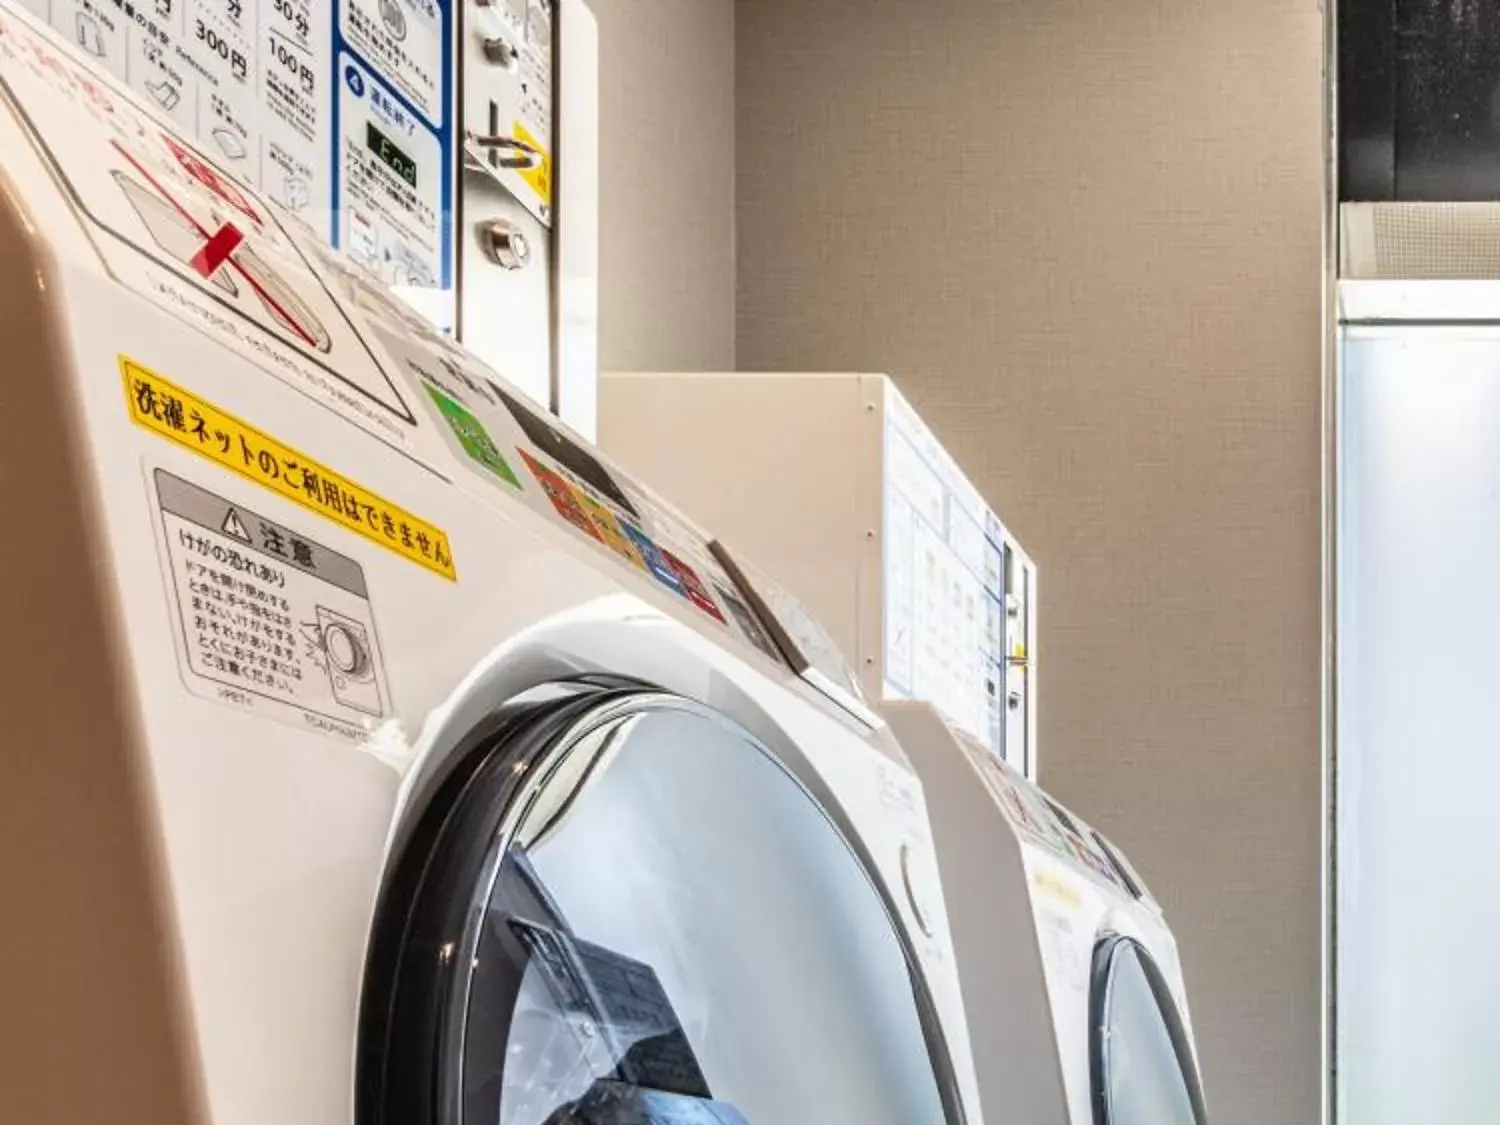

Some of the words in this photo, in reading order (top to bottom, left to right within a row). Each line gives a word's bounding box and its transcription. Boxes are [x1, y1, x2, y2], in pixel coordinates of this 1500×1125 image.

[196, 19, 248, 78] 300円
[268, 37, 315, 90] 100円
[132, 377, 450, 570] 洗濯ネットのご利用はできません
[178, 528, 286, 589] けがの恐れあり
[258, 521, 317, 571] 注意
